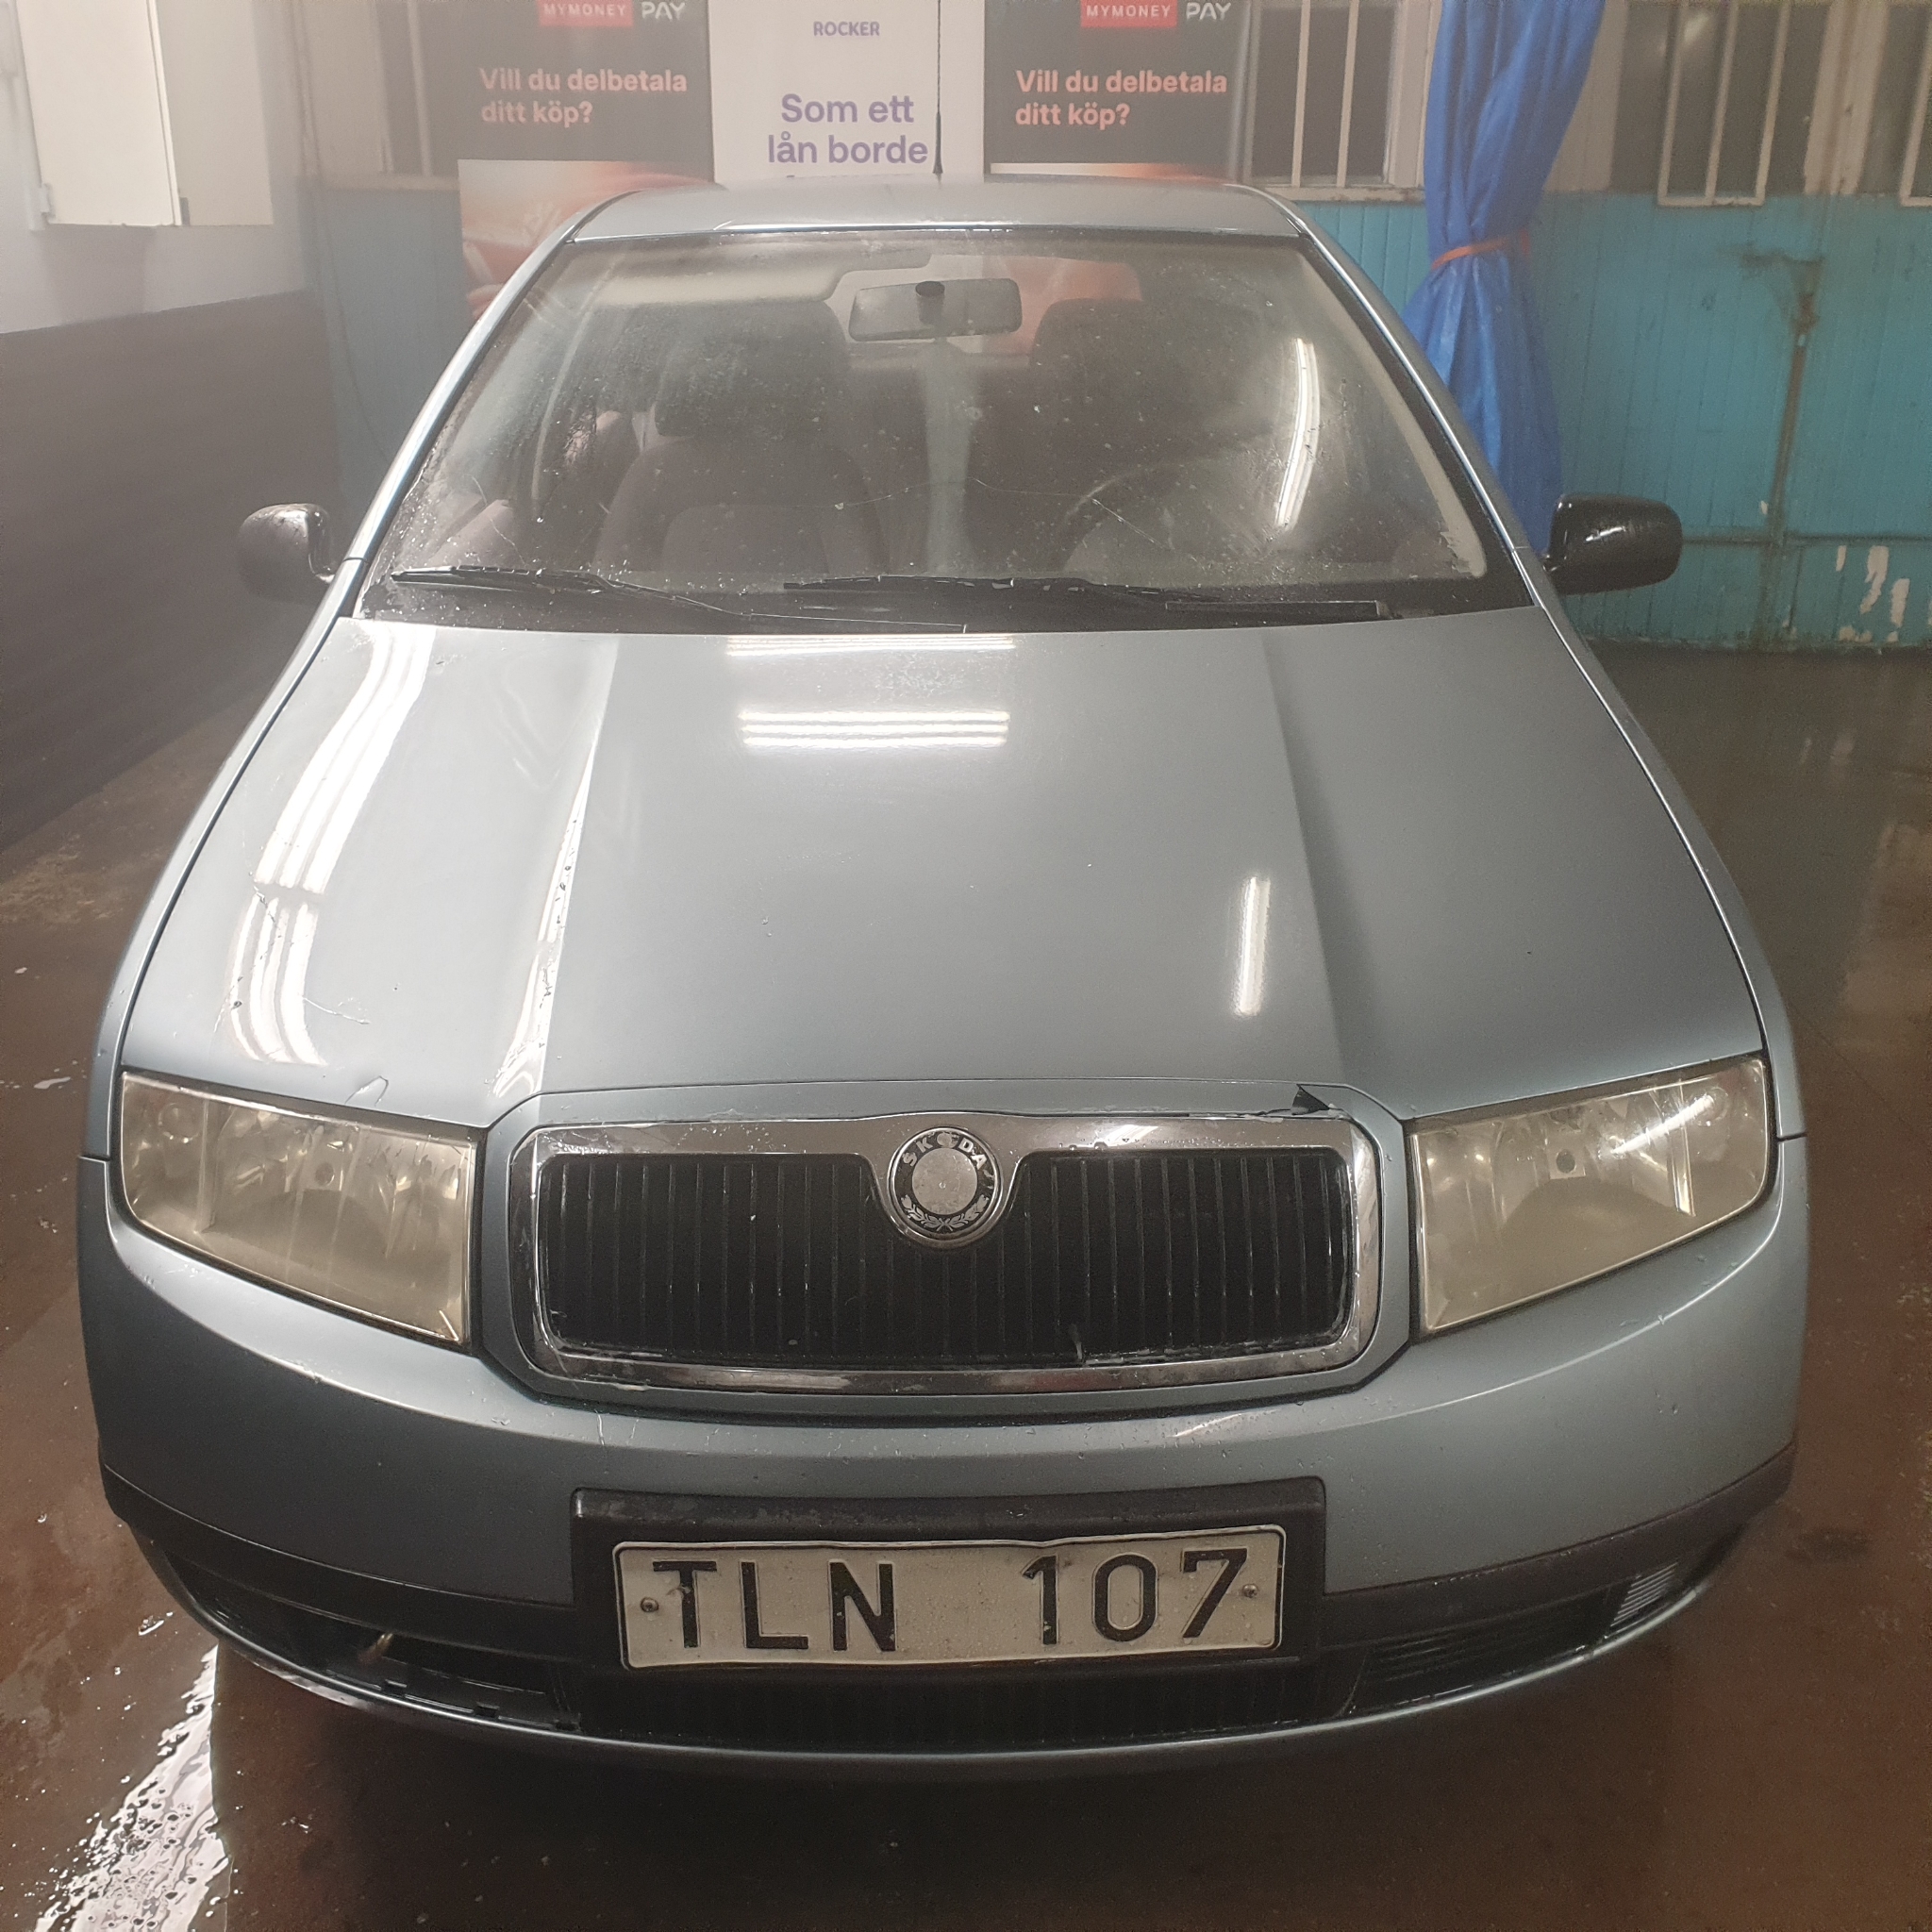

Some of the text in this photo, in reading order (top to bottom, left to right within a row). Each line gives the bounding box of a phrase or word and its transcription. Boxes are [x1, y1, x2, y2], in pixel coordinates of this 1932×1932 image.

[543, 1, 687, 21] MYMONEY PAY
[1086, 2, 1231, 21] MYMONEY PAY
[813, 21, 880, 37] ROCKER
[479, 67, 687, 92] Vill du delbetala
[1016, 69, 1227, 93] Vill du delbetala
[481, 100, 593, 128] ditt köp?
[781, 93, 914, 123] Som ett
[1015, 102, 1131, 130] ditt köp?
[768, 130, 928, 164] lån borde
[653, 1548, 1248, 1652] TLN 107
